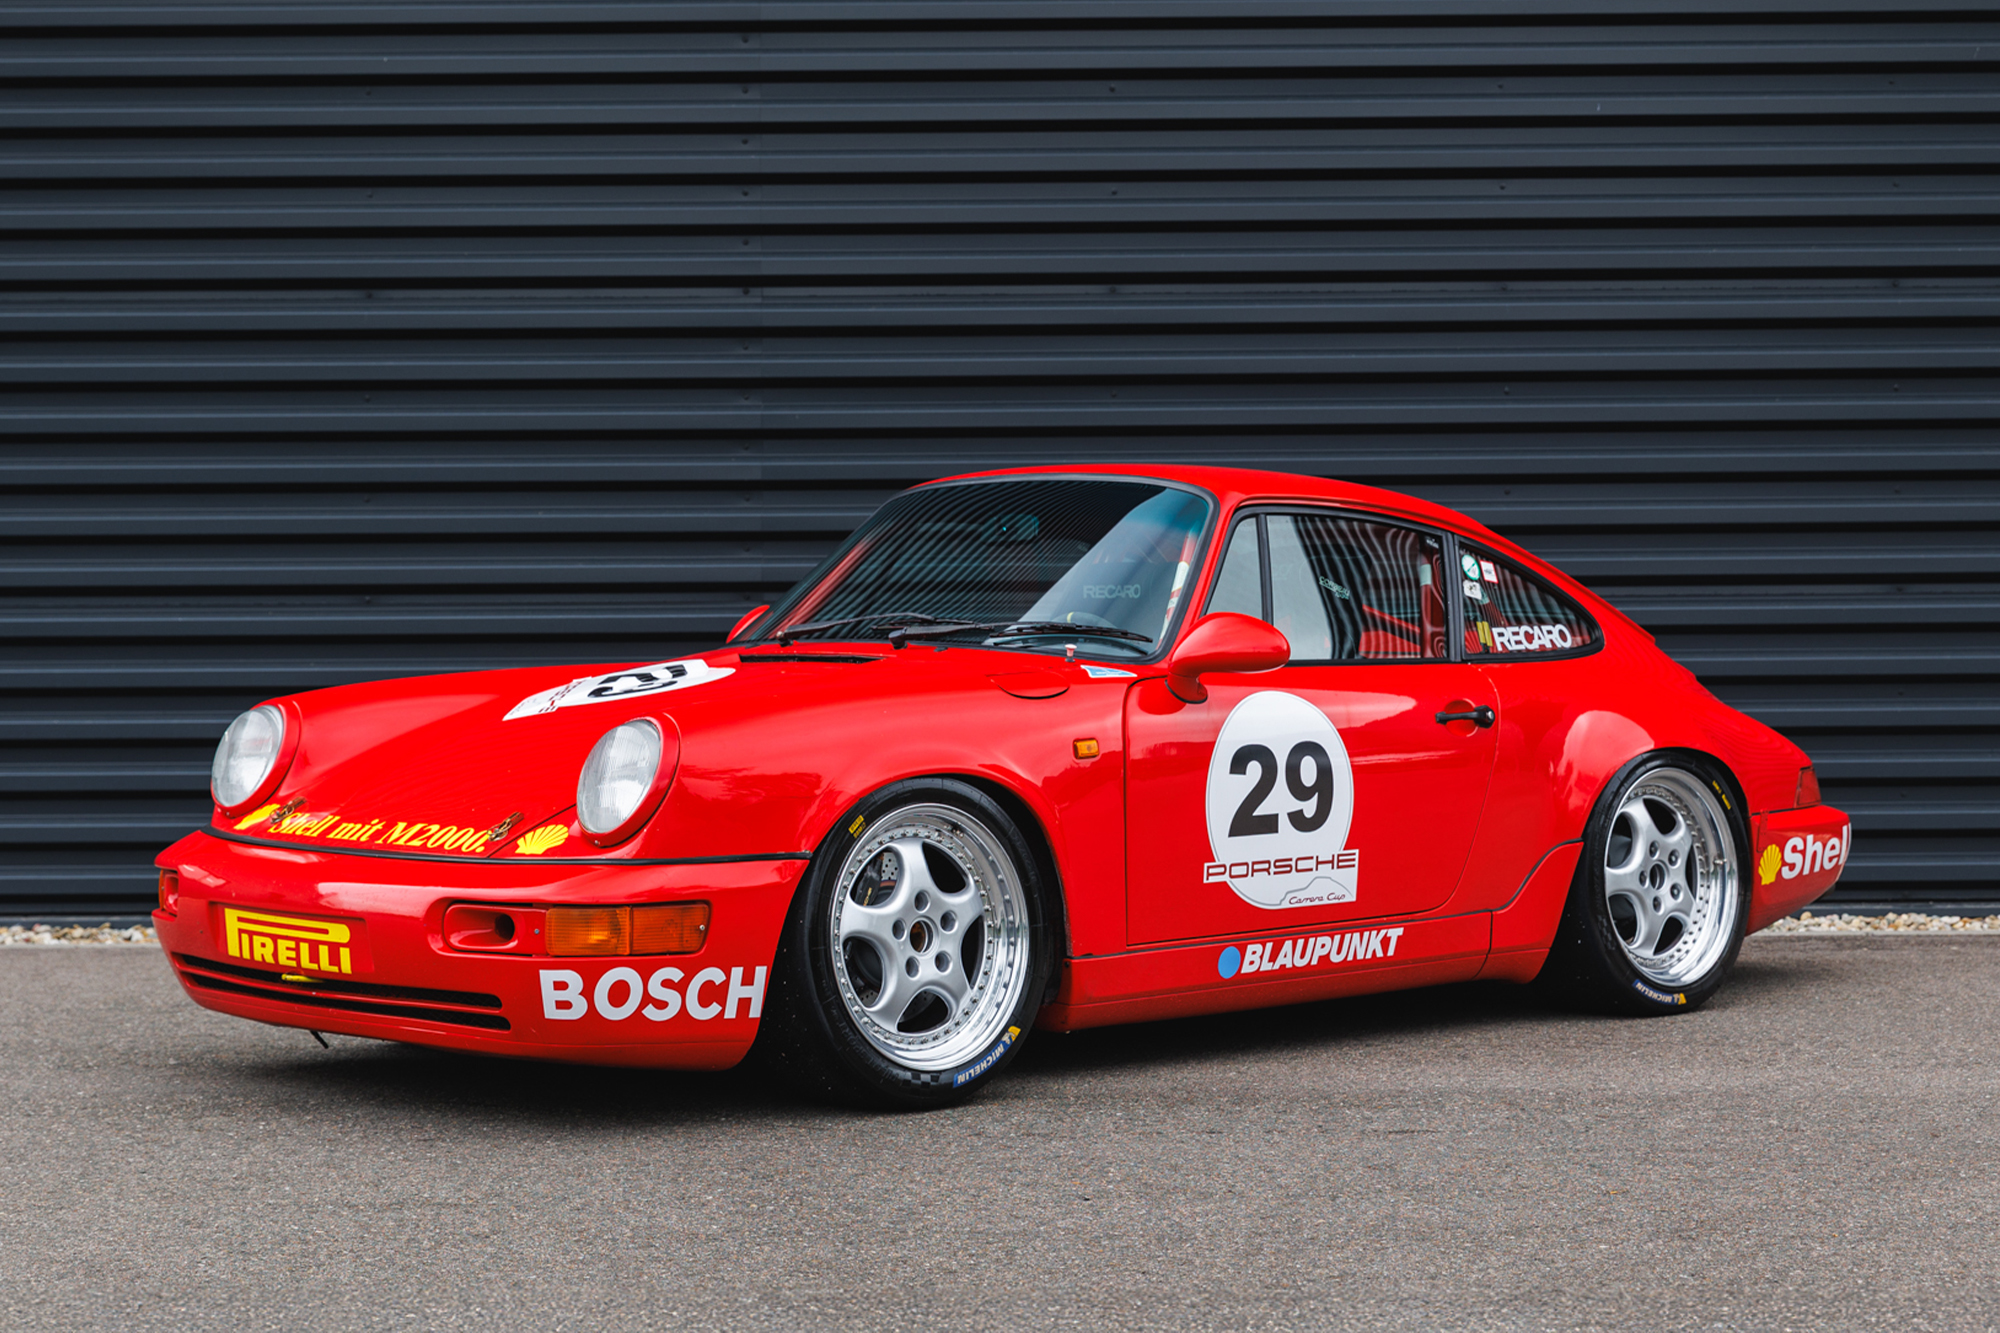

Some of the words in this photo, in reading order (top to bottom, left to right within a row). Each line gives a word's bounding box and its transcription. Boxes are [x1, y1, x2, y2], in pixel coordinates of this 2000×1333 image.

[1083, 584, 1141, 599] RECARO
[1492, 624, 1572, 651] RECARO
[1228, 740, 1334, 838] 29
[268, 812, 341, 837] Shell
[326, 818, 386, 842] mit
[375, 821, 488, 853] M2000.
[1206, 852, 1356, 881] PORSCHE
[1288, 896, 1324, 905] Carrera
[1326, 892, 1346, 901] Cup
[224, 907, 352, 974] PIRELLI
[1241, 927, 1404, 974] BLAUPUNKT
[539, 965, 767, 1022] BOSCH
[1635, 982, 1673, 1003] MICHELIN
[957, 1043, 1005, 1084] MICHELIN
